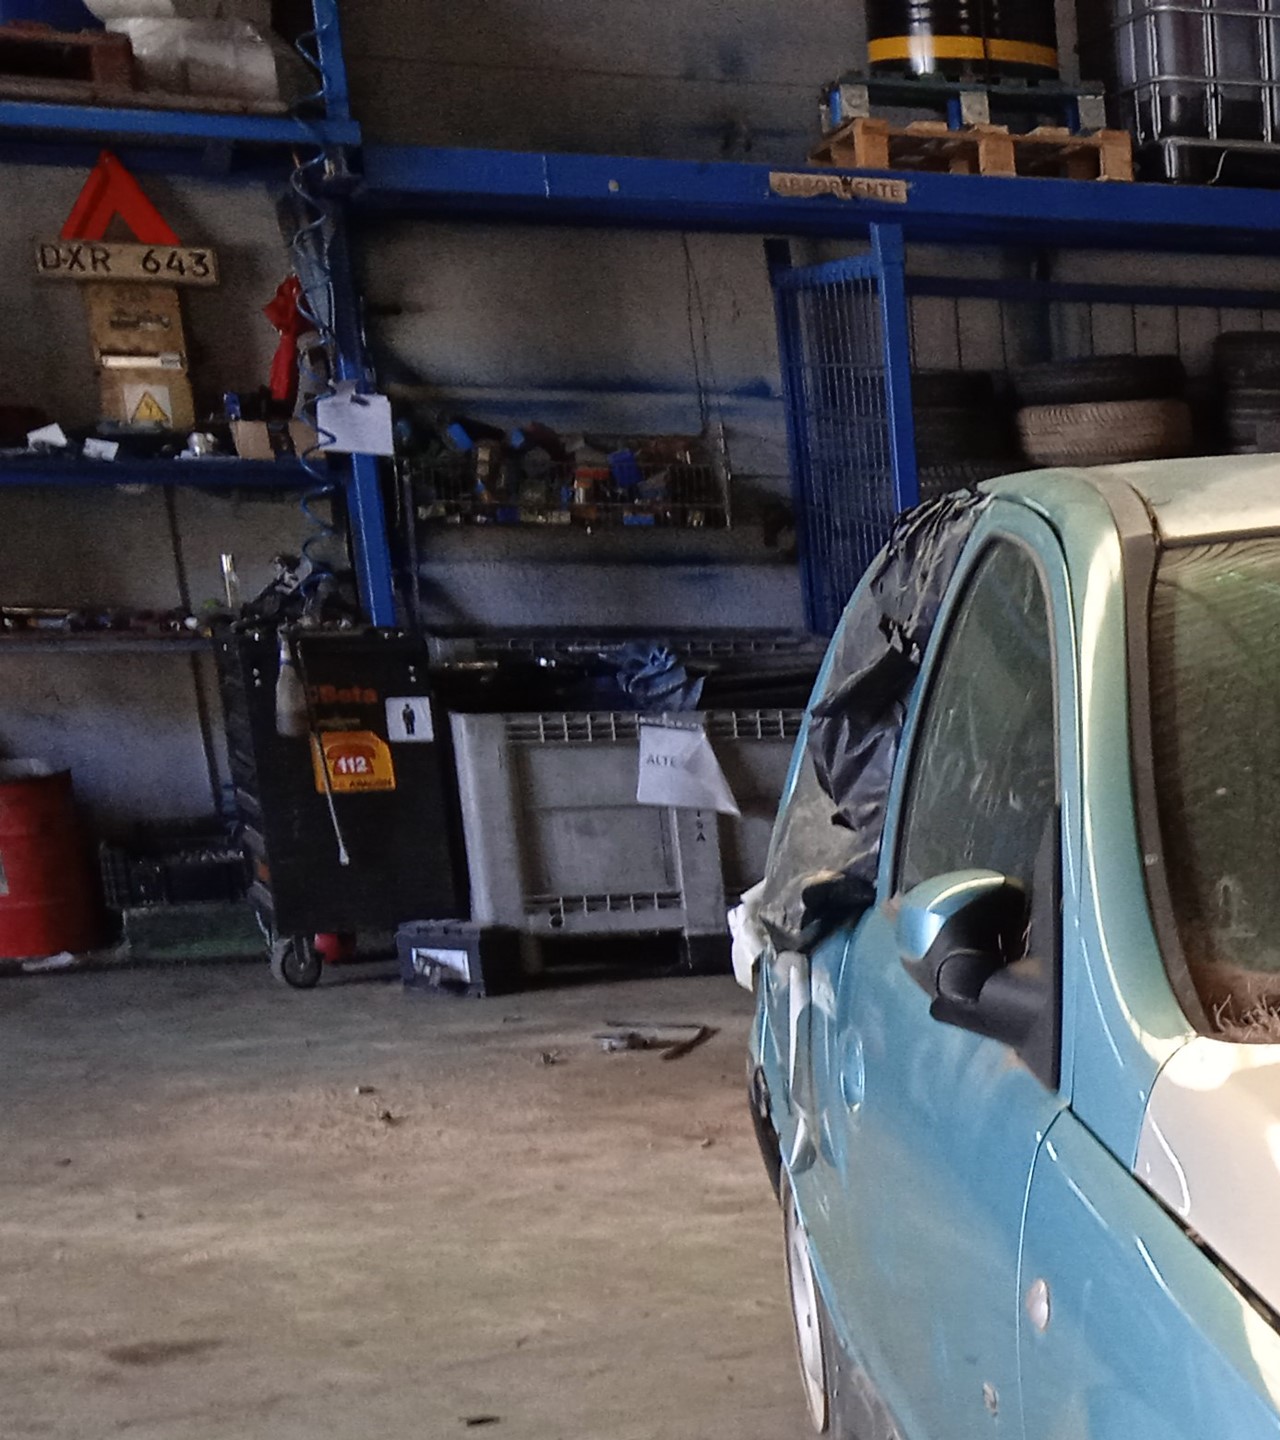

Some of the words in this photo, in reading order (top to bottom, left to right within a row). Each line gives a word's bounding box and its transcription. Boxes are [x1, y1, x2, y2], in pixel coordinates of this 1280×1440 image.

[778, 176, 900, 199] ABSORENTE
[141, 249, 210, 277] 643
[338, 756, 368, 774] 112
